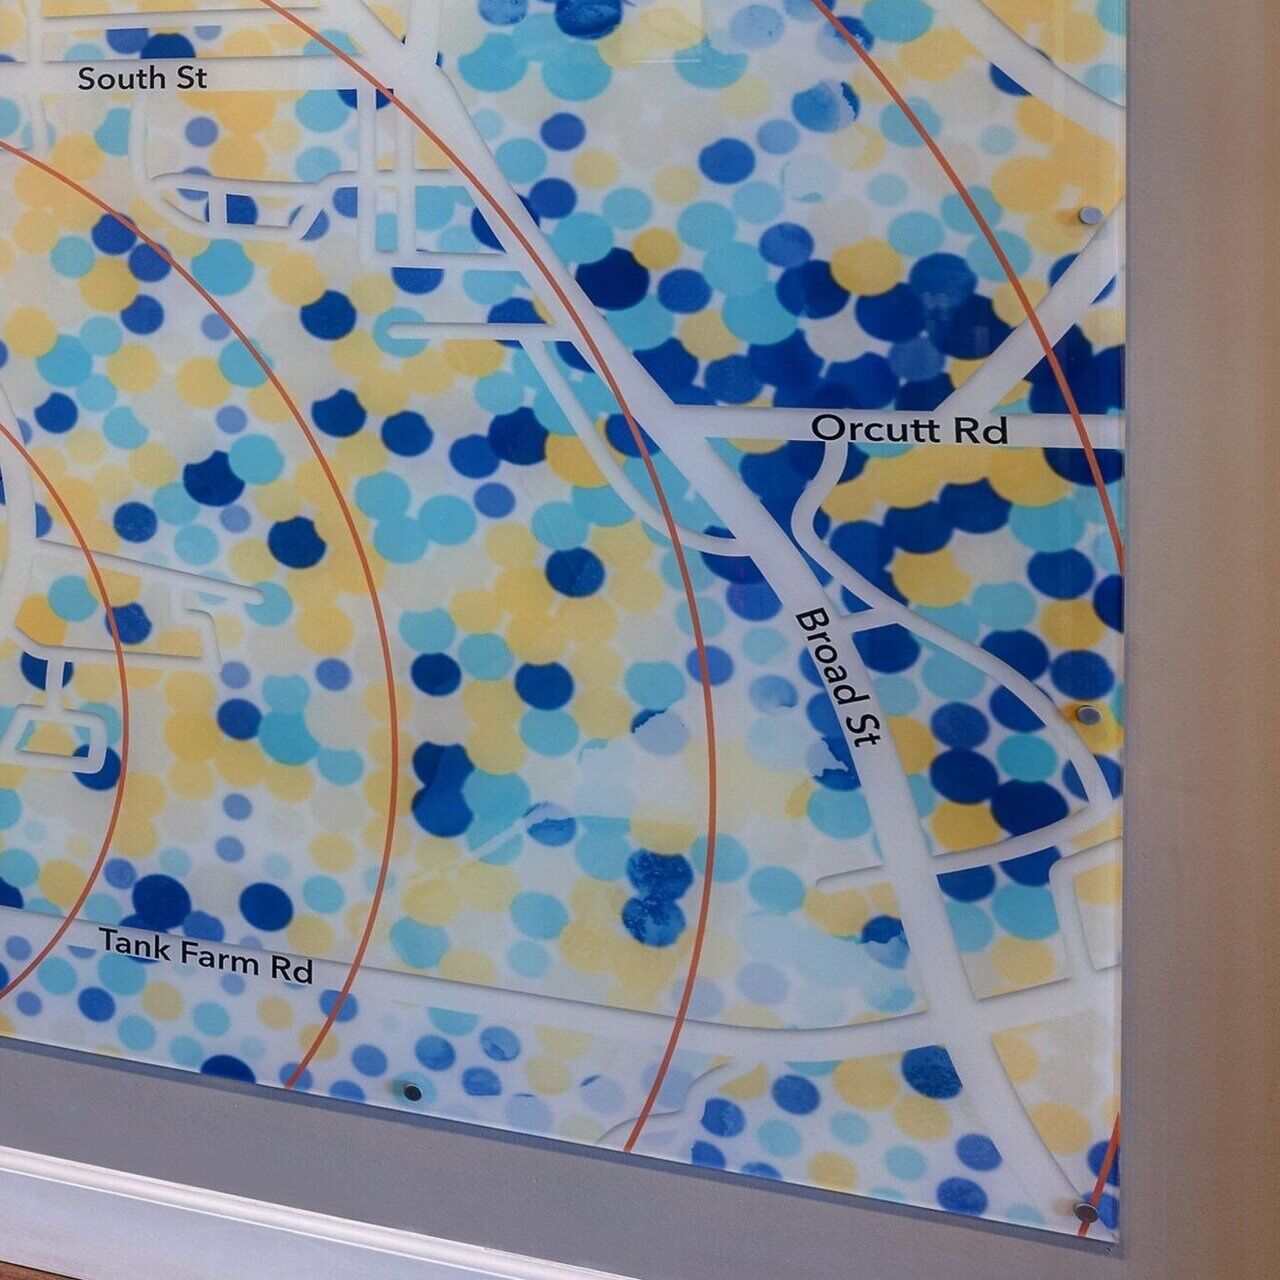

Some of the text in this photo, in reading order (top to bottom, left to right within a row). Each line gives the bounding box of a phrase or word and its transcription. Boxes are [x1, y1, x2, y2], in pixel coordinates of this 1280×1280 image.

[78, 64, 208, 91] South St
[811, 413, 1009, 446] Orcutt Rd
[795, 606, 880, 749] Broad St
[98, 927, 314, 987] Tank Farm Rd
